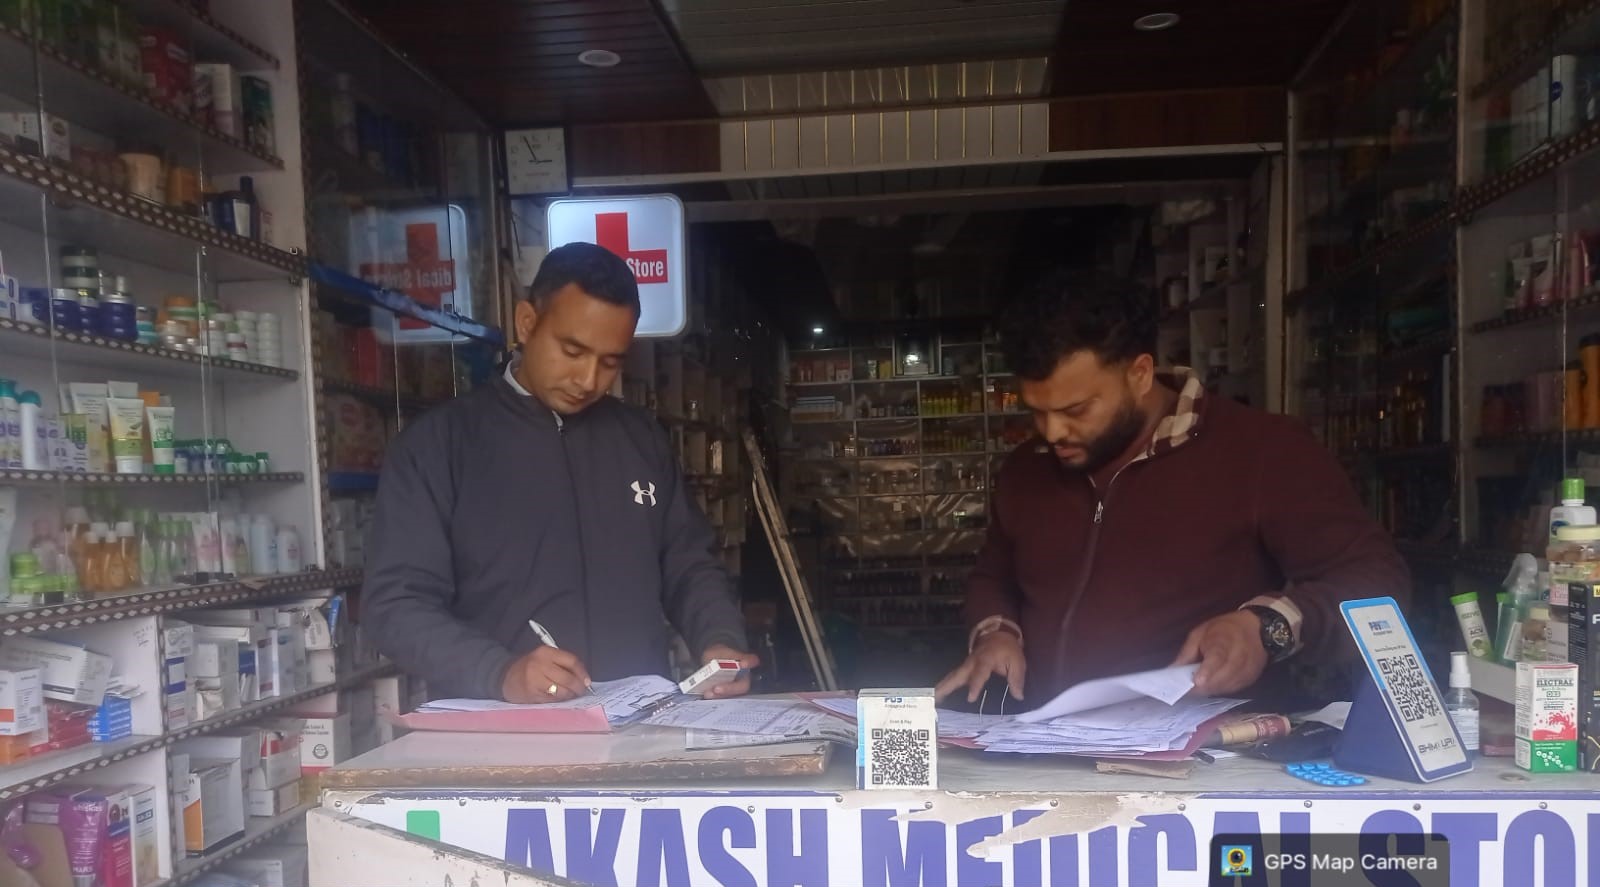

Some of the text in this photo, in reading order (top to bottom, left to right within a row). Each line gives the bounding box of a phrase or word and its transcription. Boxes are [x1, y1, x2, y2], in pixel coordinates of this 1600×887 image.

[625, 257, 664, 277] Store
[1536, 679, 1574, 687] ELECTRAL
[504, 806, 828, 887] AKASH
[1359, 809, 1600, 887] STO
